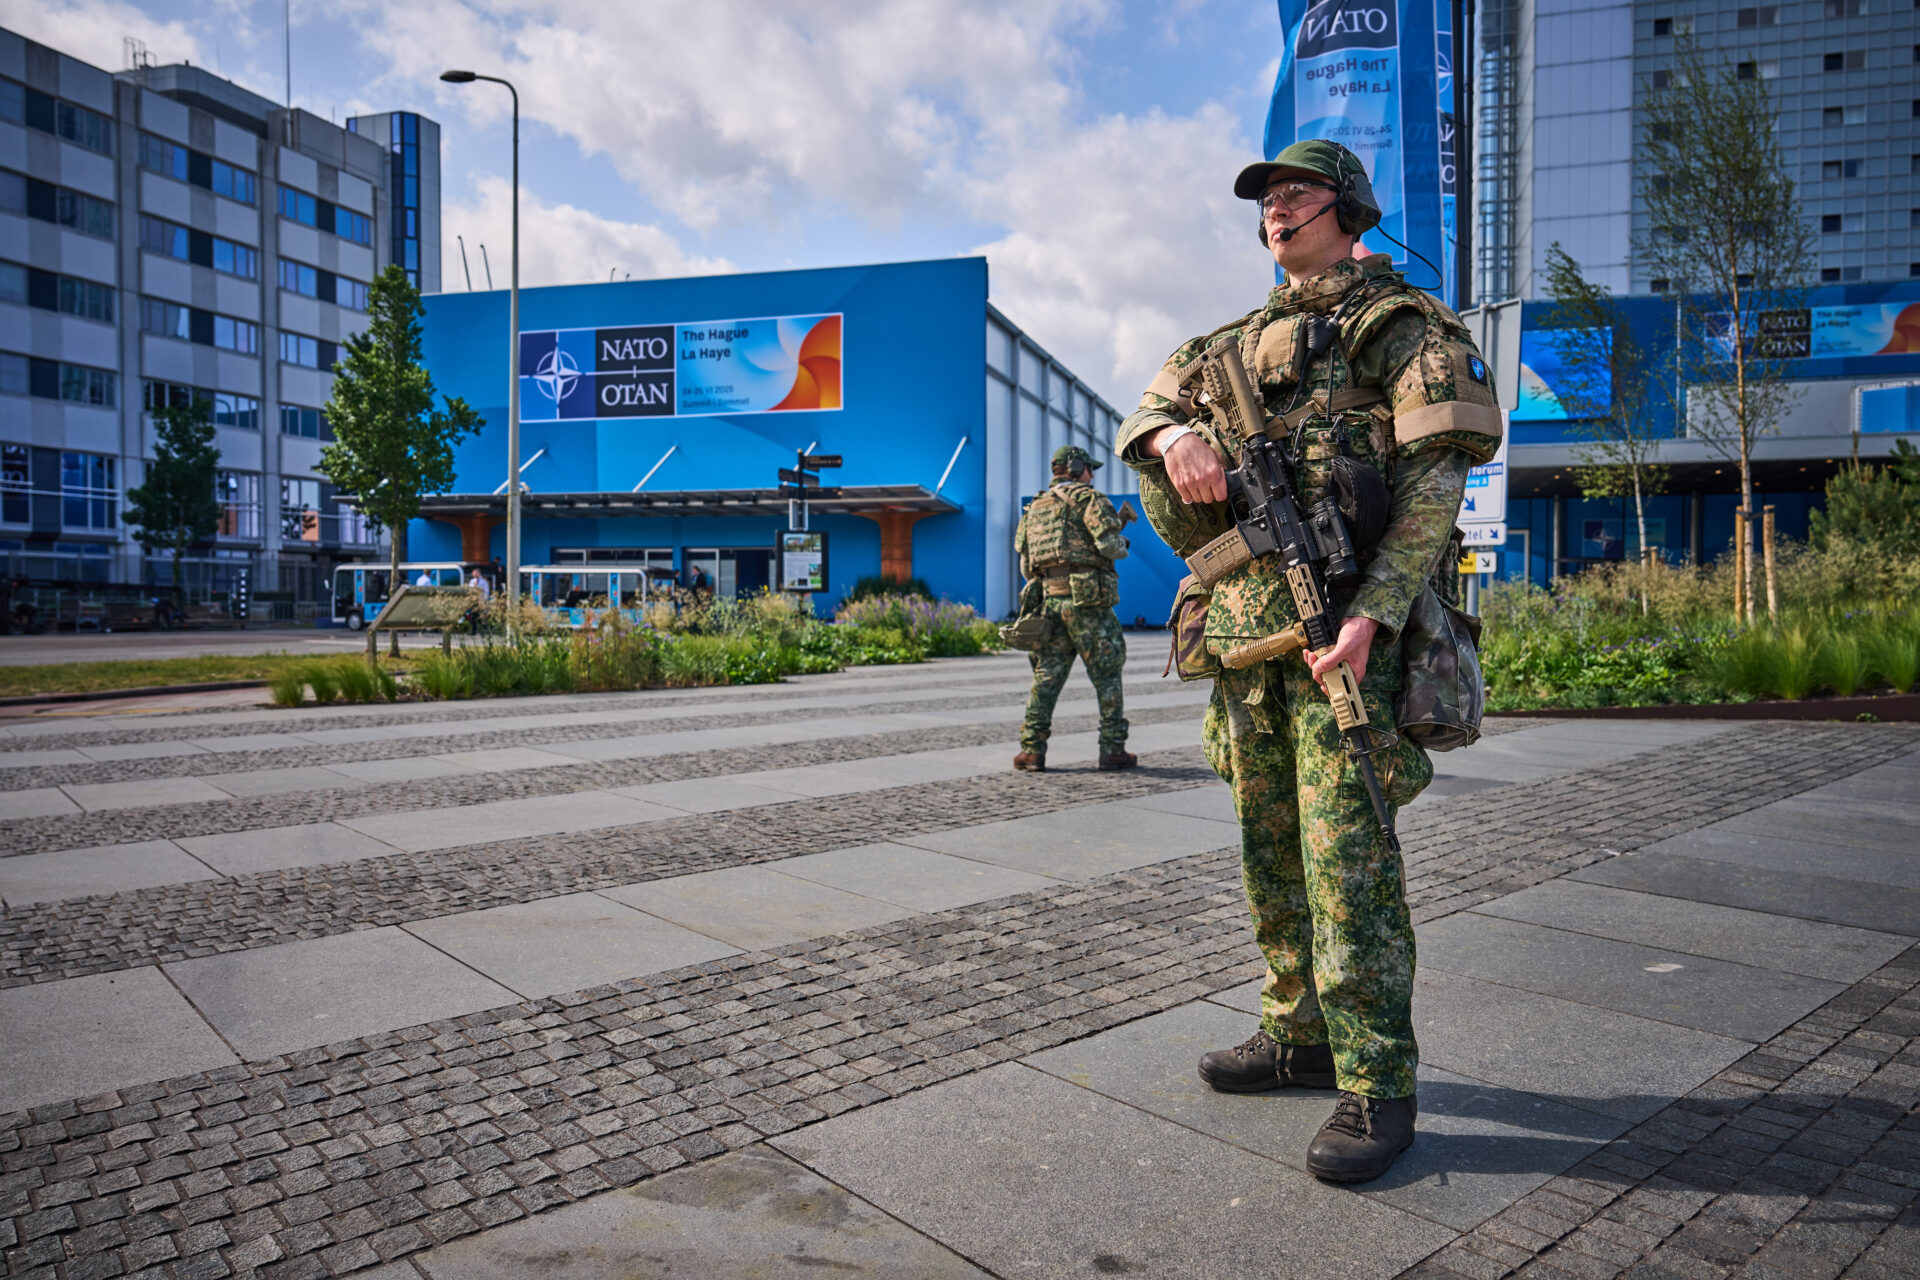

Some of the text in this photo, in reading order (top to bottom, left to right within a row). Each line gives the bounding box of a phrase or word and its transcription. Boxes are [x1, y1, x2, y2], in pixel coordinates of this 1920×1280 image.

[682, 328, 749, 342] The Hague
[601, 336, 668, 361] NATO
[682, 348, 732, 361] La Haye
[601, 382, 669, 407] OTAN
[1472, 465, 1503, 476] forum
[1463, 528, 1483, 541] tel
